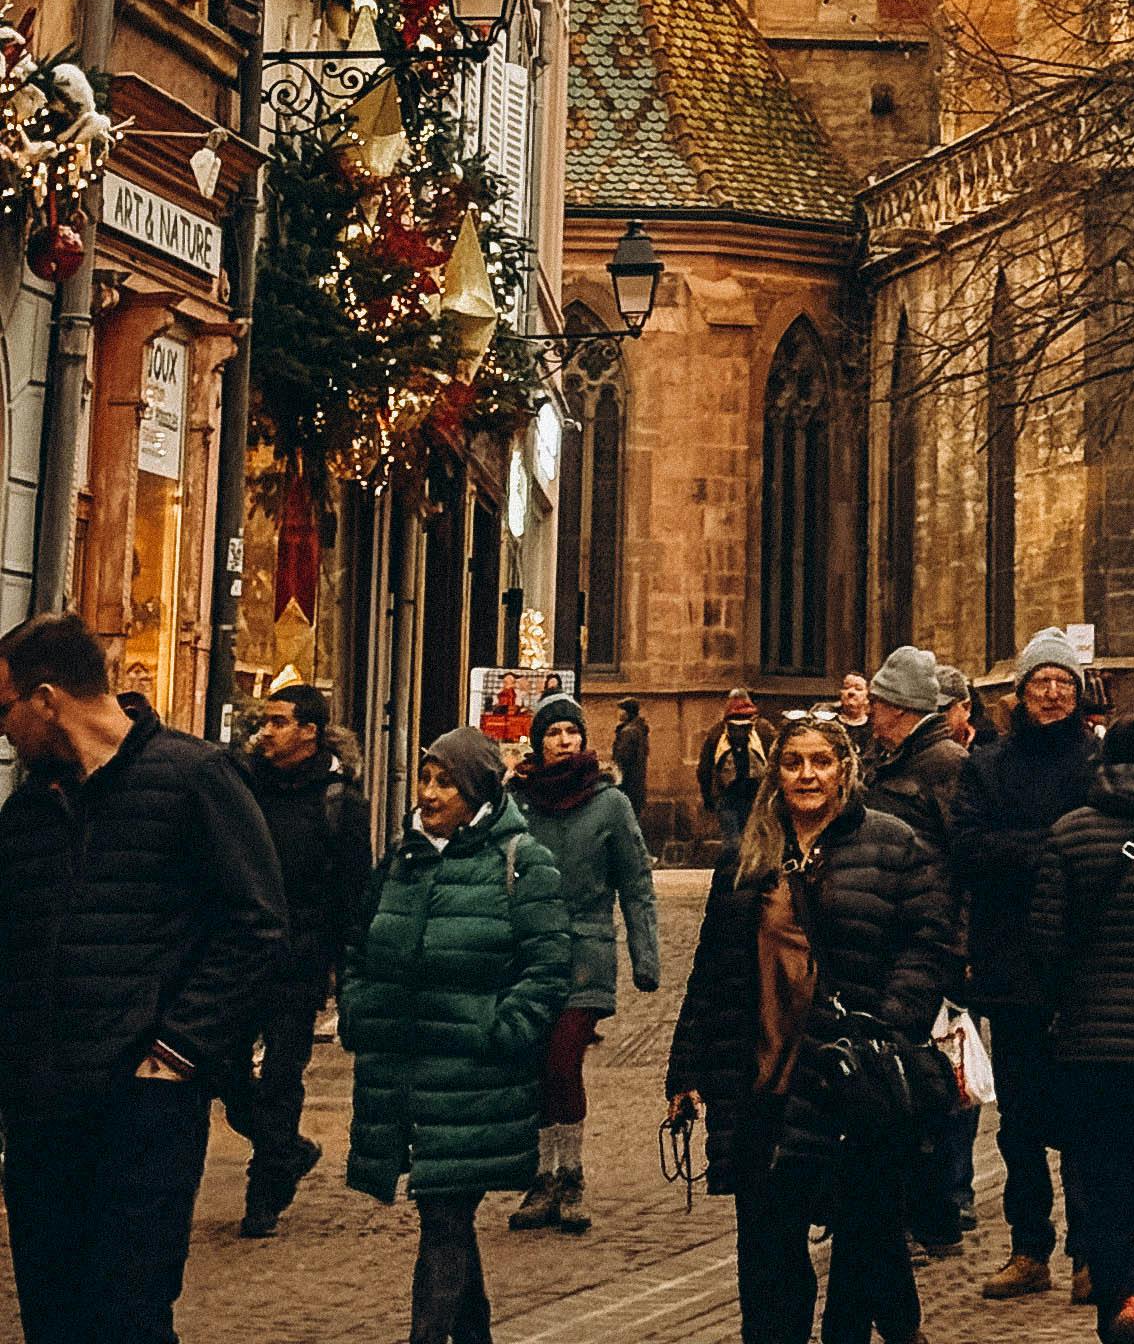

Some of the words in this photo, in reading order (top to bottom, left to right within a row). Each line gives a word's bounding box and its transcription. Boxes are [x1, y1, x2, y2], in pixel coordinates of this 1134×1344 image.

[115, 185, 143, 234] ART
[145, 198, 154, 241] &
[160, 203, 213, 270] NATURE
